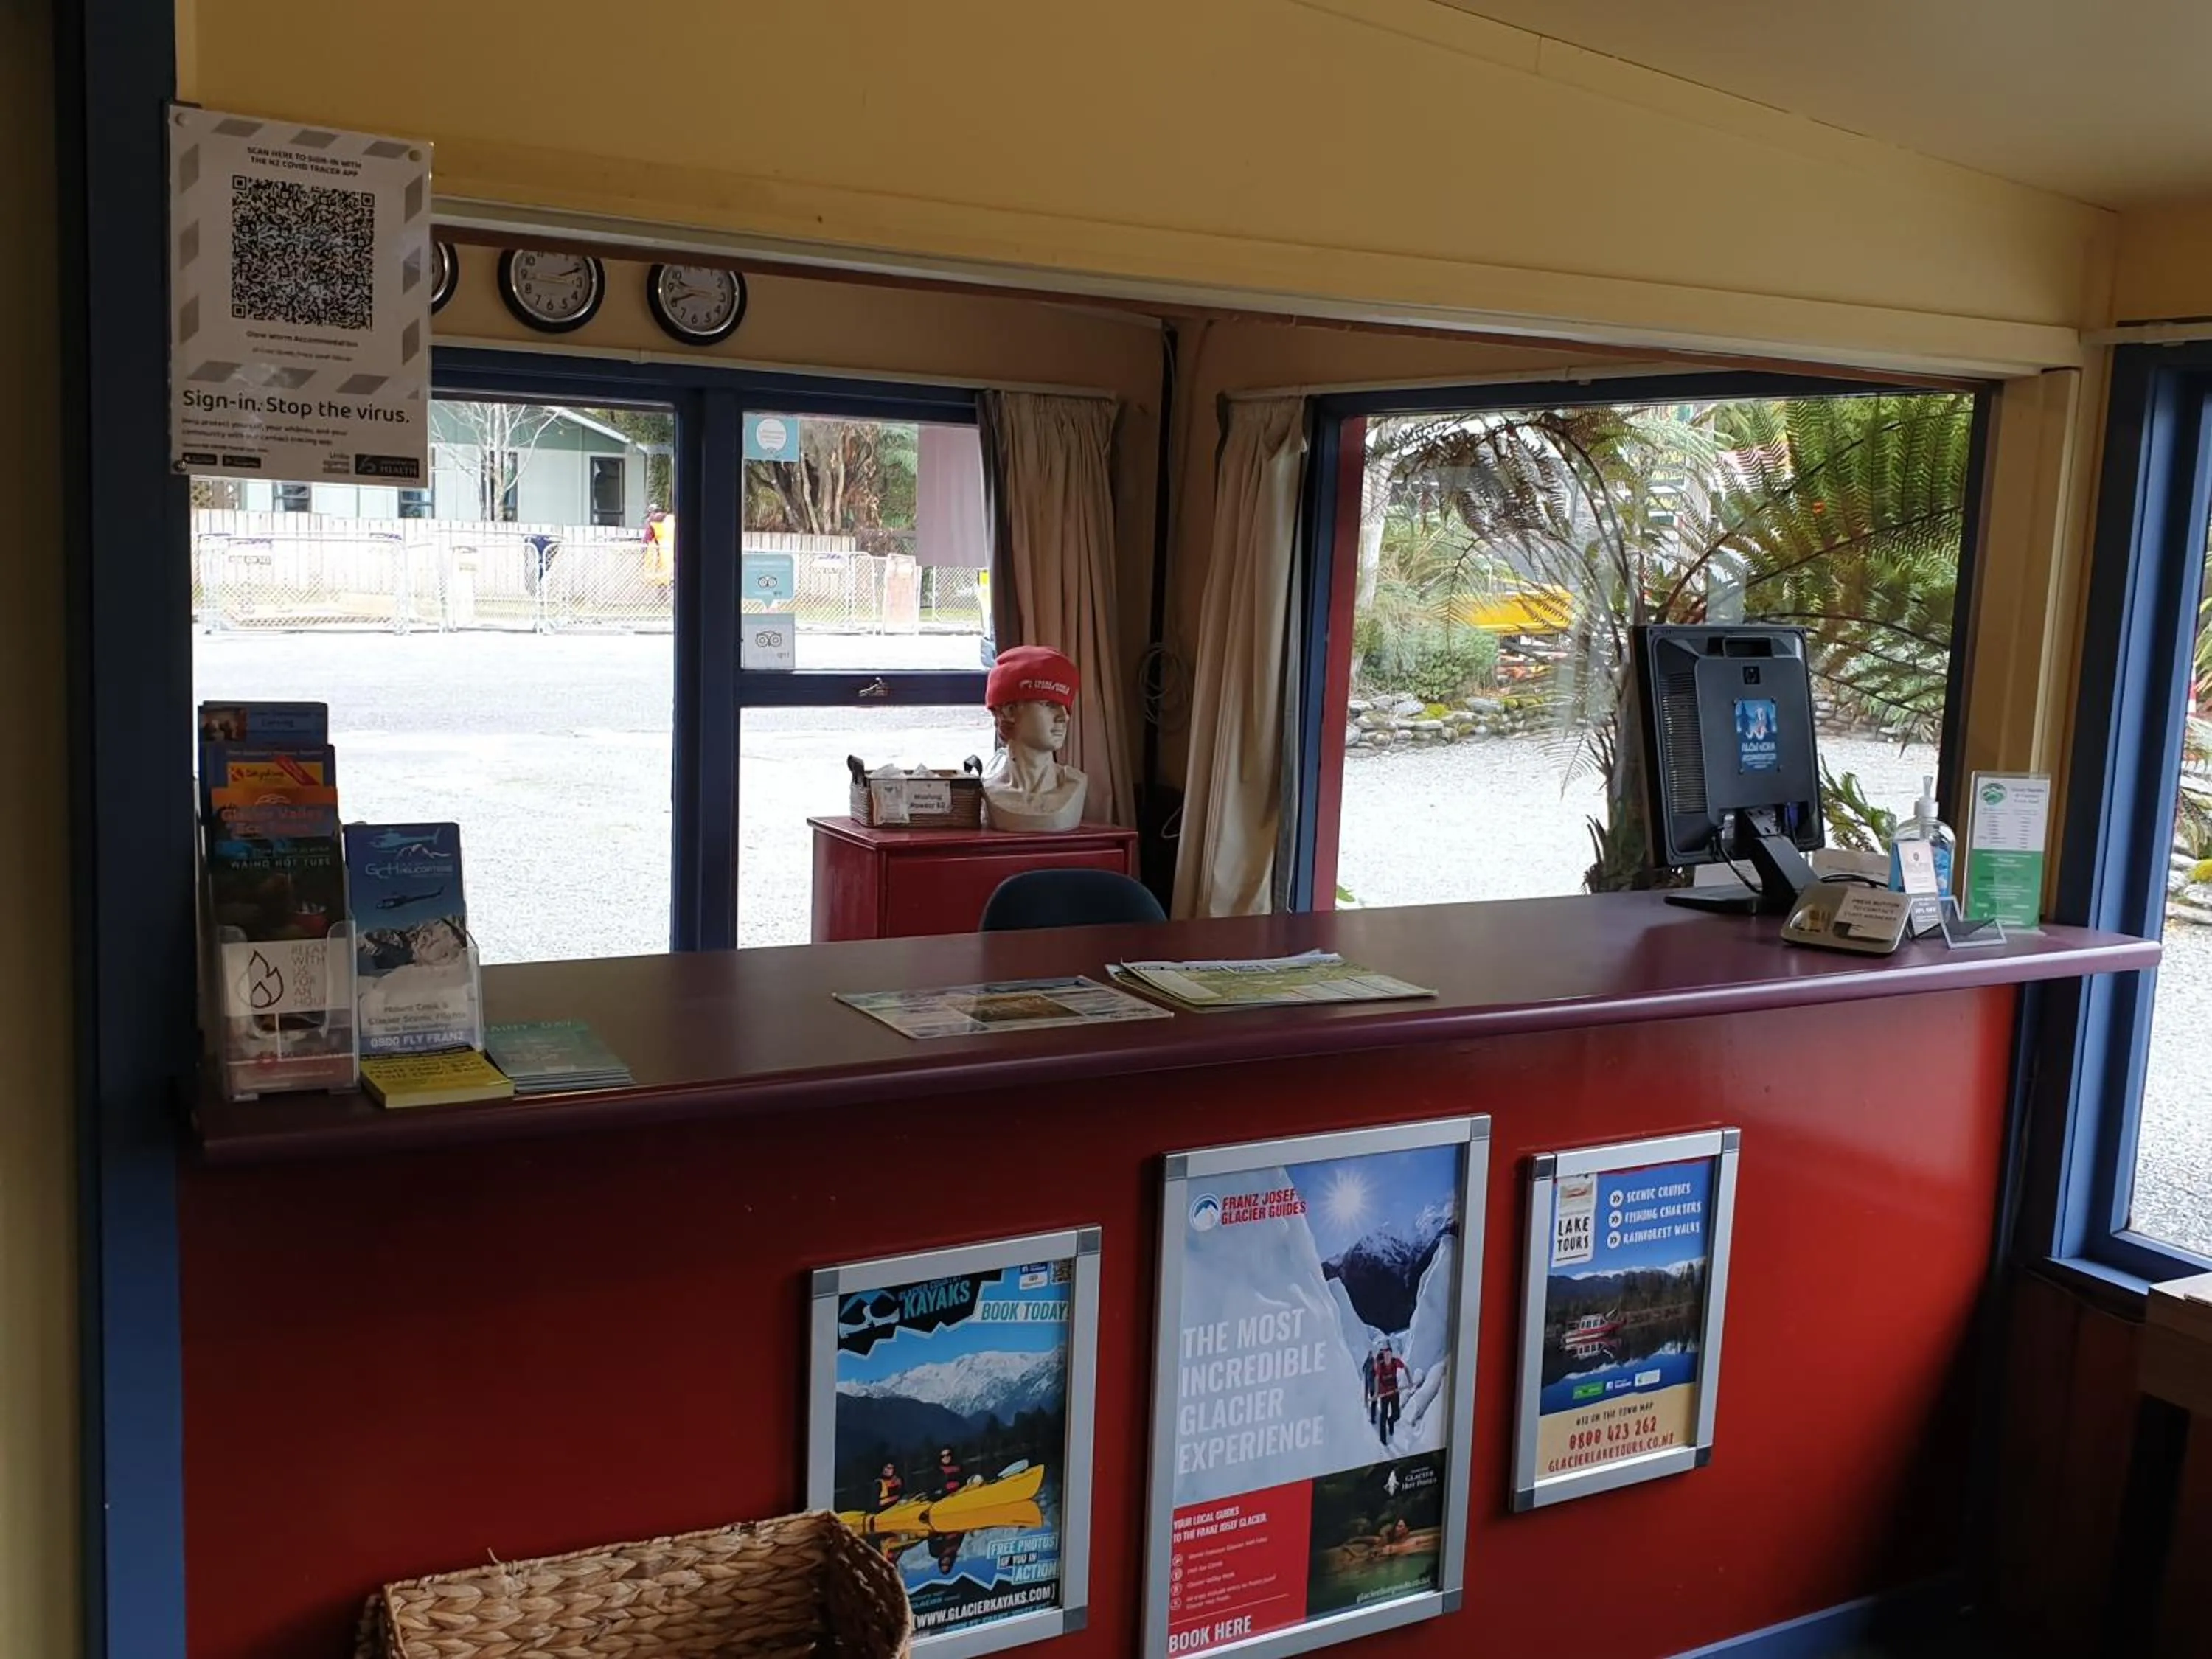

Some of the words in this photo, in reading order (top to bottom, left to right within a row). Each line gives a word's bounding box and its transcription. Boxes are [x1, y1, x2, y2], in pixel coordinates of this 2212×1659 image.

[271, 150, 293, 159] HERE
[296, 153, 306, 161] TO
[251, 156, 266, 164] THE
[282, 160, 307, 170] COVID
[310, 164, 340, 175] TRACER
[525, 256, 535, 266] 10
[521, 268, 528, 279] 9
[576, 276, 583, 288] 3
[672, 271, 682, 280] 10
[525, 283, 532, 294] 8
[667, 282, 674, 293] 9
[717, 277, 724, 290] 2
[536, 294, 542, 306] 7
[561, 297, 568, 310] 5
[571, 290, 578, 301] 4
[719, 292, 726, 303] 3
[546, 299, 554, 311] 6
[681, 307, 686, 319] 7
[713, 304, 721, 314] 4
[691, 313, 698, 325] 6
[703, 311, 712, 323] 5
[182, 389, 261, 412] Sign-in.
[266, 396, 313, 420] Stop
[318, 400, 352, 418] the
[357, 403, 411, 423] virus.
[403, 1034, 425, 1045] FLY
[1222, 1192, 1259, 1210] FRANZ
[1262, 1187, 1296, 1205] JOSEF
[1627, 1188, 1657, 1203] SCENIC
[1658, 1181, 1691, 1198] CRUISES
[1221, 1207, 1266, 1225] GLACIER
[1268, 1200, 1307, 1218] GUIDES
[1624, 1207, 1658, 1223] FISHING
[1660, 1201, 1702, 1218] CHARTERS
[1558, 1216, 1590, 1237] LAKE
[1623, 1225, 1672, 1245] RAINFOREST
[1674, 1221, 1700, 1237] WALKS
[1557, 1234, 1590, 1253] TOURS
[904, 1279, 971, 1320] KAYAKS
[981, 1303, 1019, 1321] BOOK
[1183, 1321, 1230, 1360] THE
[1237, 1308, 1306, 1349] MOST
[1182, 1340, 1327, 1398] INCREDIBLE
[1180, 1388, 1284, 1436] GLACIER
[1568, 1428, 1601, 1450] 0800
[1607, 1422, 1629, 1441] 423
[1635, 1415, 1657, 1436] 262
[1178, 1415, 1324, 1475] EXPERIENCE
[1174, 1516, 1192, 1530] YOUR
[1193, 1512, 1214, 1526] LOCAL
[1215, 1506, 1239, 1520] GUIDES
[1173, 1532, 1182, 1544] TO
[1183, 1528, 1195, 1541] THE
[1197, 1524, 1218, 1537] FRANZ
[1219, 1519, 1238, 1532] JOSEF
[1239, 1512, 1267, 1528] GLACIER
[990, 1540, 1015, 1556] FREE
[1017, 1536, 1056, 1553] PHOTOS
[1013, 1554, 1027, 1564] YOU
[1015, 1561, 1057, 1582] ACTION
[1169, 1625, 1210, 1653] BOOK
[1214, 1615, 1252, 1641] HERE
